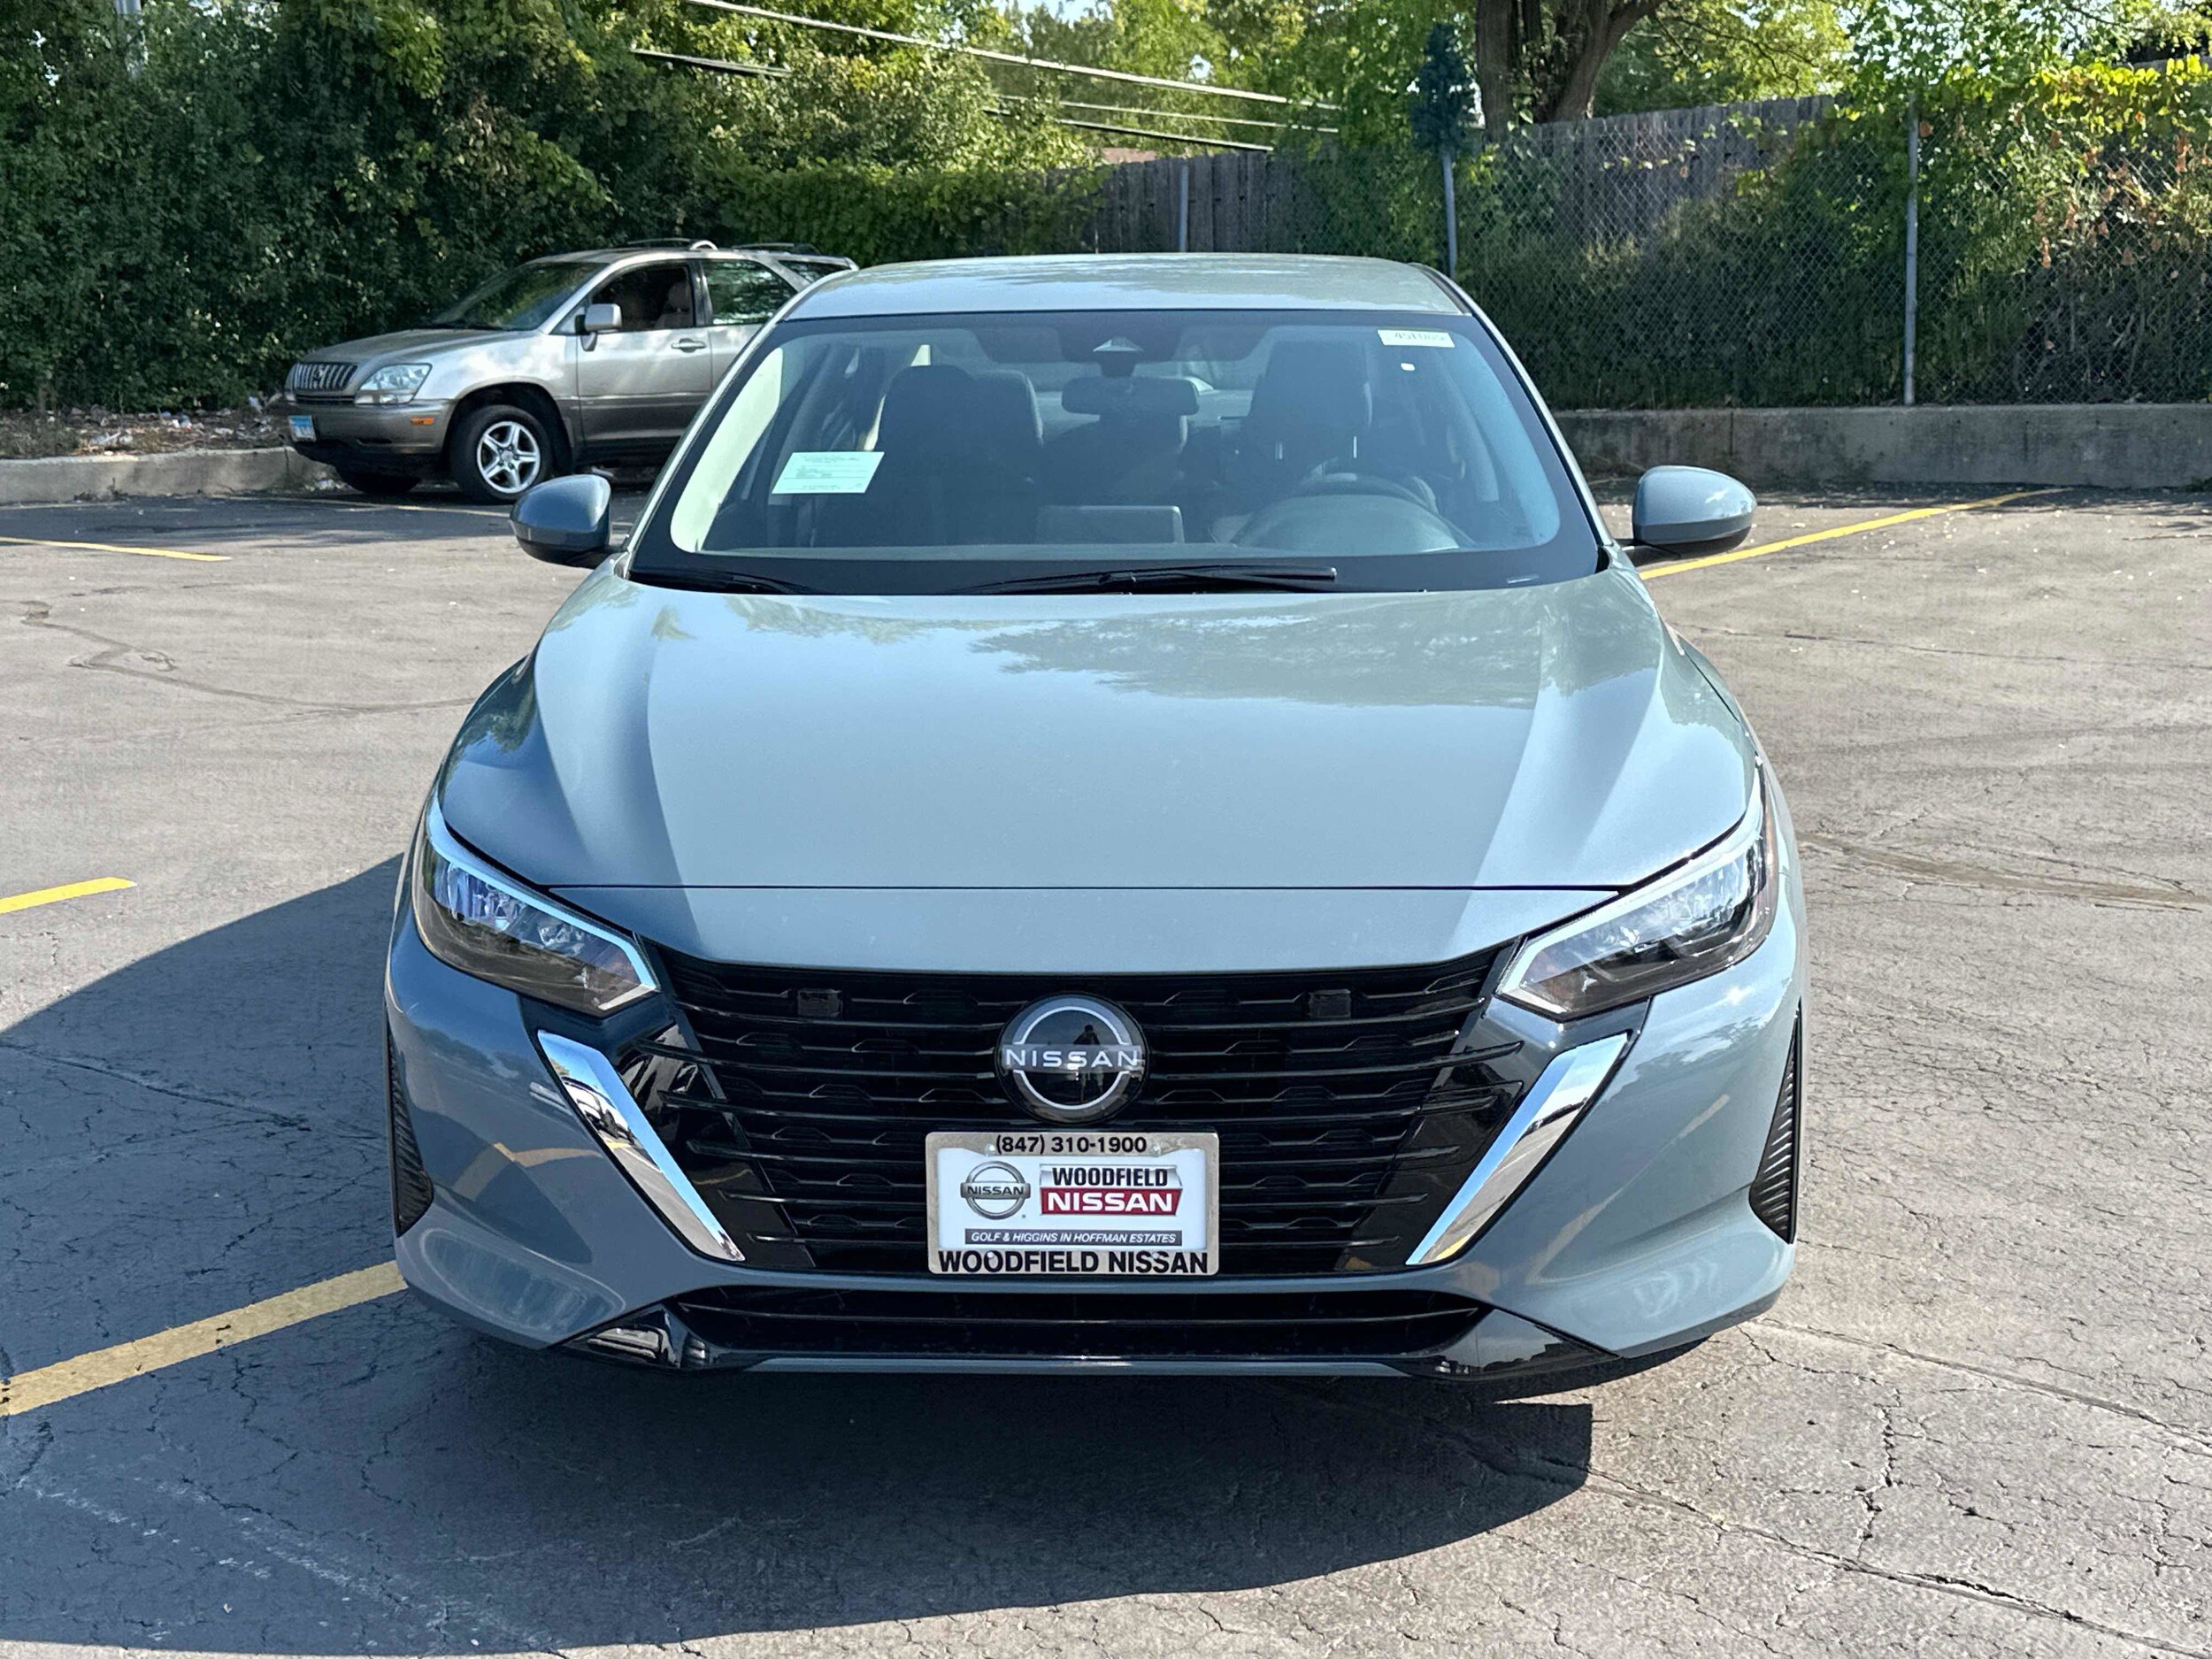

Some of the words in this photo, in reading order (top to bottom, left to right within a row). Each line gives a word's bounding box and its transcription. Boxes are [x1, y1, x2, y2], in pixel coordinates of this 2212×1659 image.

[1006, 1048, 1138, 1068] NISSAN
[996, 1134, 1045, 1155] (847)
[1051, 1136, 1147, 1154] 310-1900
[1052, 1167, 1168, 1187] WOODFIELD
[967, 1186, 1025, 1196] NISSAN
[1048, 1192, 1173, 1213] NISSAN
[972, 1232, 1002, 1241] GOLF
[1002, 1233, 1010, 1242] &
[1012, 1233, 1059, 1243] HIGGINS
[1060, 1233, 1073, 1242] IN
[1073, 1233, 1127, 1243] HOFFMAN
[1129, 1233, 1177, 1244] ESTATES
[938, 1250, 1099, 1272] WOODFIELD
[1108, 1250, 1209, 1274] NISSAN
